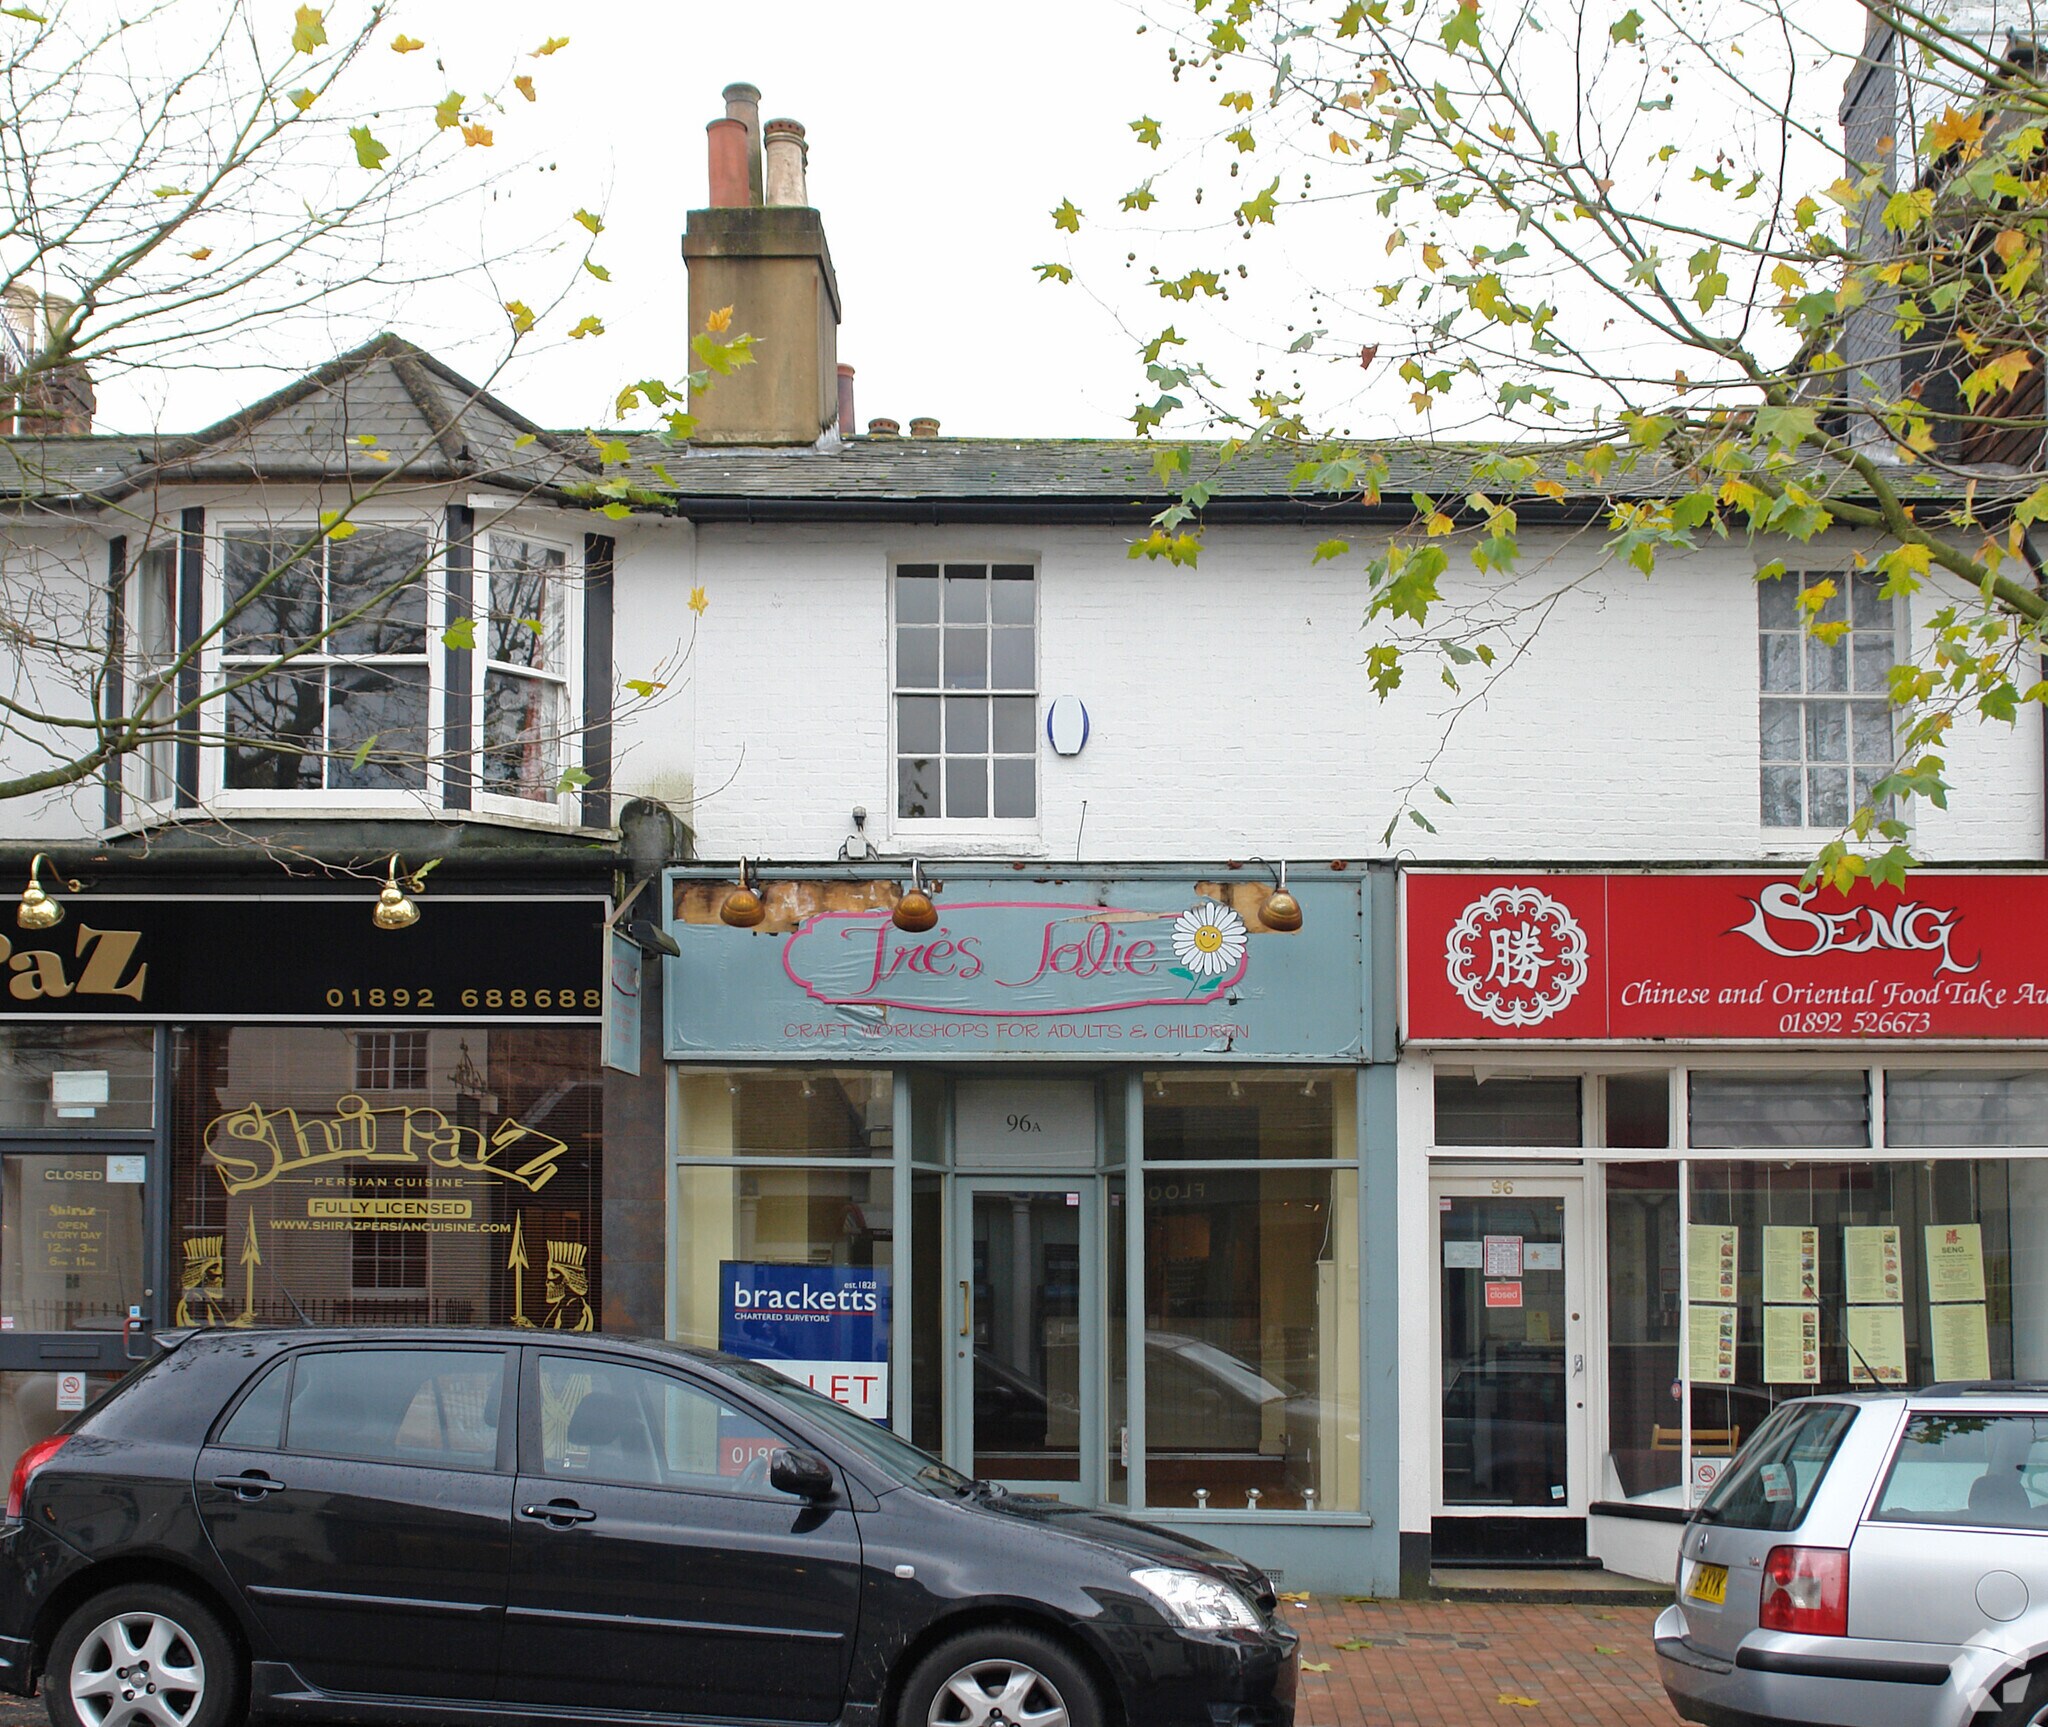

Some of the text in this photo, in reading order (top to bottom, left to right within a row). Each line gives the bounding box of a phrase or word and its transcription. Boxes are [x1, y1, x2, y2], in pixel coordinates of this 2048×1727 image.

[1720, 881, 1982, 980] SENG
[1485, 920, 1555, 988] 勝
[326, 989, 600, 1008] 01892 688688
[1621, 979, 1710, 1006] Chinese
[1718, 980, 1767, 1005] and
[1772, 980, 1875, 1005] Oriental
[1883, 980, 1942, 1008] Food
[1945, 980, 2007, 1009] Take
[784, 1023, 853, 1038] CRAFT
[861, 1022, 989, 1038] WORKSHOPS
[997, 1023, 1040, 1038] FOR
[1047, 1024, 1123, 1039] ADULTS
[1154, 1024, 1249, 1039] CHILDREN
[1779, 1012, 1931, 1034] 01892 526673
[45, 1170, 102, 1180] CLOSED
[314, 1177, 464, 1188] PERSIAN CUISINE
[1491, 1179, 1514, 1195] 96
[313, 1201, 466, 1215] FULLY LICENSED
[57, 1221, 88, 1230] OPEN
[270, 1219, 511, 1233] WWW.SHIRAZPERSIANCUISINE.COM
[42, 1231, 102, 1240] EVERY DAY
[734, 1281, 877, 1312] bracketts
[734, 1312, 830, 1323] CHARTERED SURVEYORS
